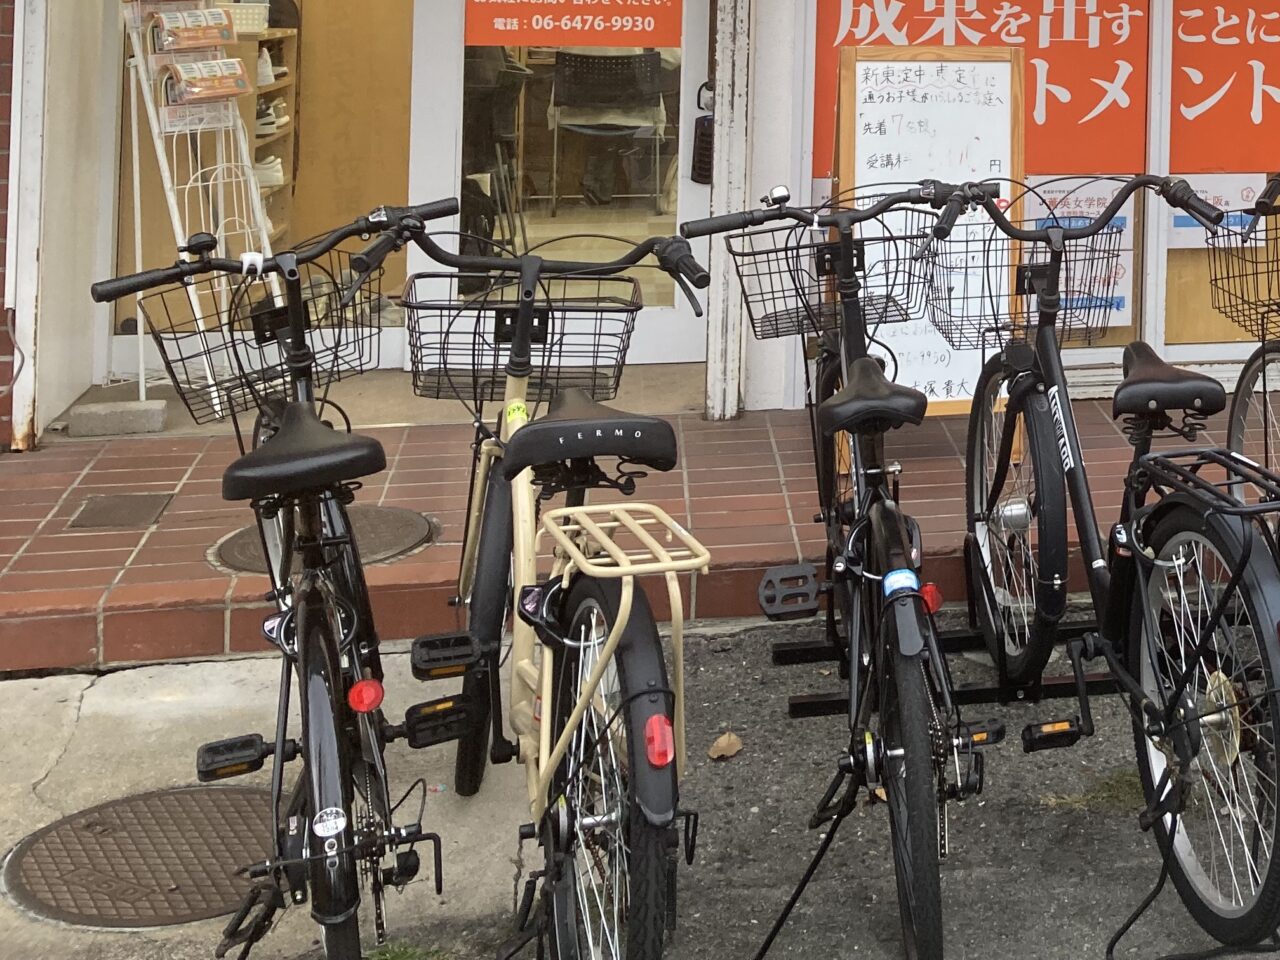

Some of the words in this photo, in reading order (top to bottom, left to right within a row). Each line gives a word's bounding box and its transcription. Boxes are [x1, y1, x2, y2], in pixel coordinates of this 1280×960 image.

[1177, 6, 1280, 45] ことに
[559, 429, 642, 445] FERMO
